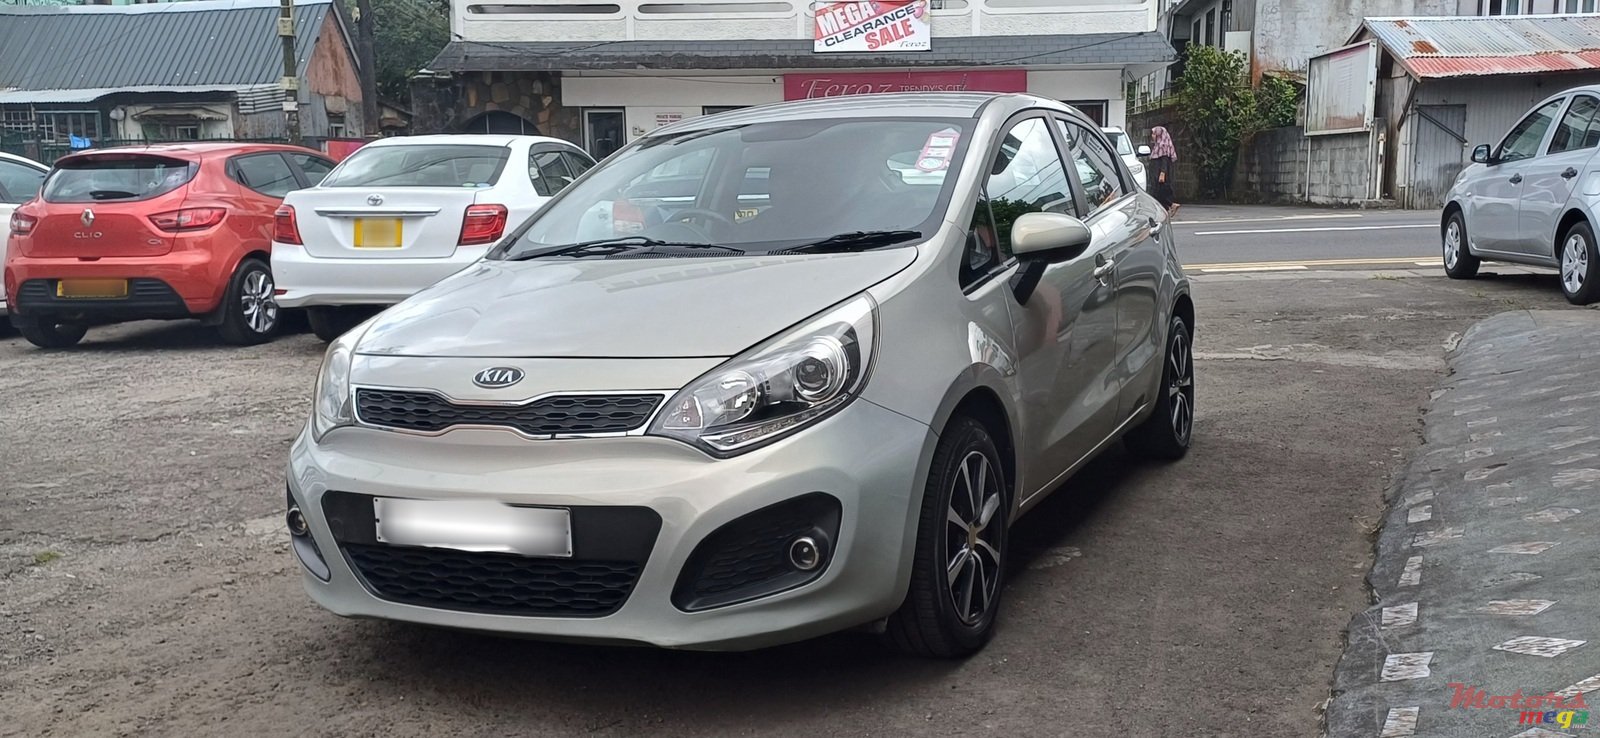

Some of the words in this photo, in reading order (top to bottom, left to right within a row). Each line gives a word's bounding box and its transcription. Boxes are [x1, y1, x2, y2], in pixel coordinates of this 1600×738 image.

[816, 1, 876, 36] MEGA
[824, 5, 916, 46] CLEARANCE
[865, 18, 915, 50] SALE
[480, 370, 513, 382] KIA
